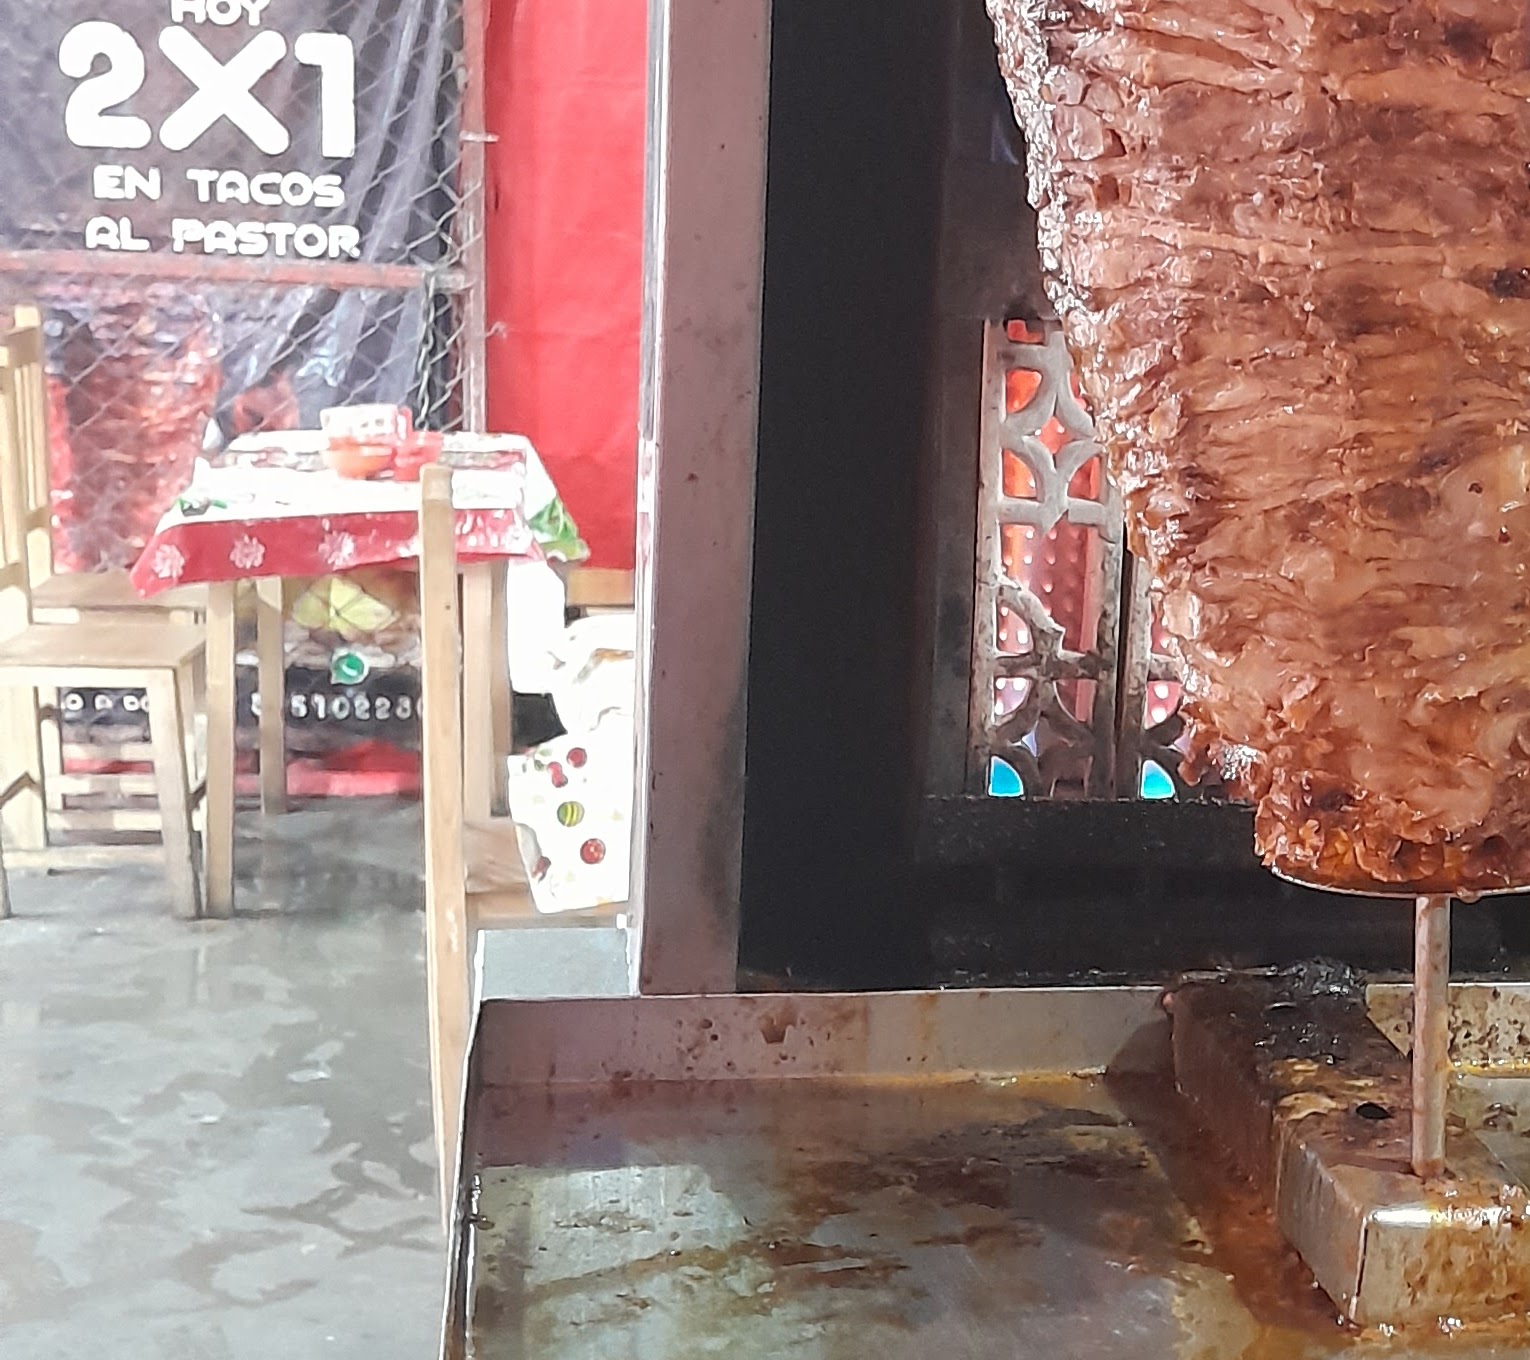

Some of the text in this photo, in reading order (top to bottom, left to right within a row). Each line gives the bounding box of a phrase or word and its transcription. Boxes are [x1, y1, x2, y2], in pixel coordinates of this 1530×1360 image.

[58, 21, 356, 158] 2X1
[93, 164, 345, 208] EN TACOS
[84, 215, 361, 259] AL PASTOR
